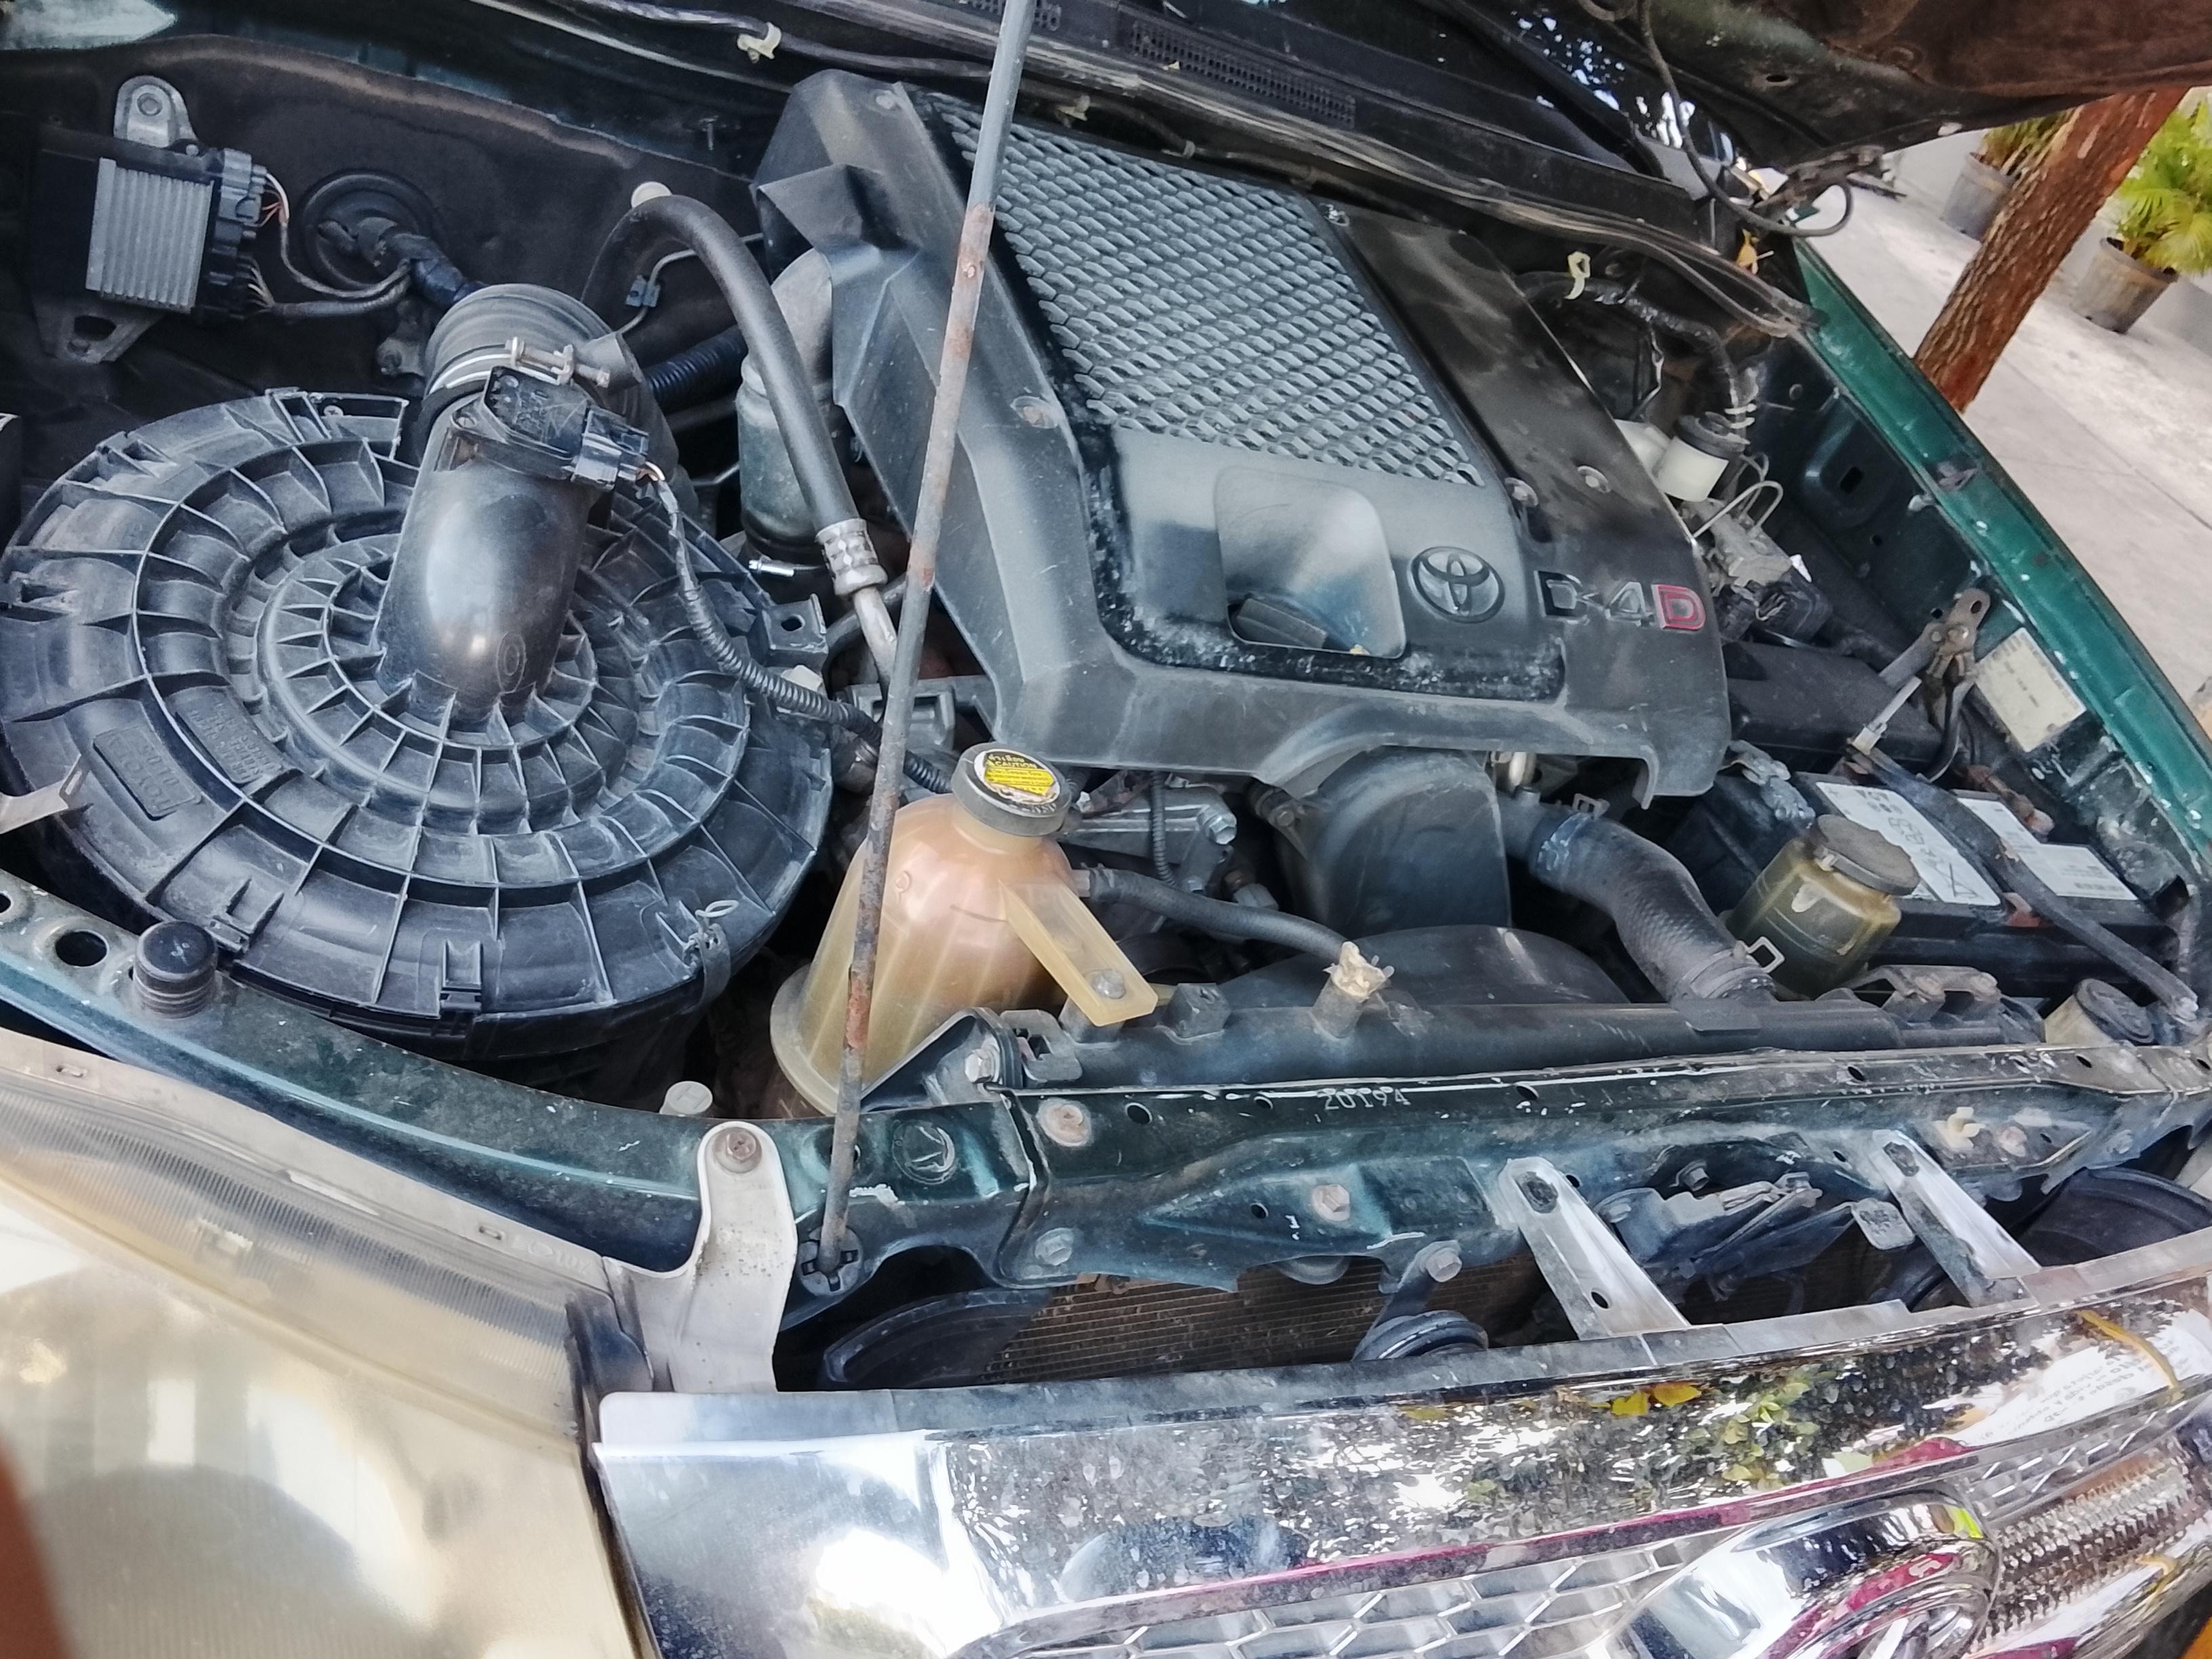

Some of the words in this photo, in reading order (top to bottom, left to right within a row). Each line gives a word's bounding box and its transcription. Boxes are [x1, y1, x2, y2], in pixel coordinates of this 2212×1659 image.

[1534, 570, 1706, 631] D-4D
[994, 761, 1038, 769] CAUTION
[1317, 1086, 1411, 1110] 20194
